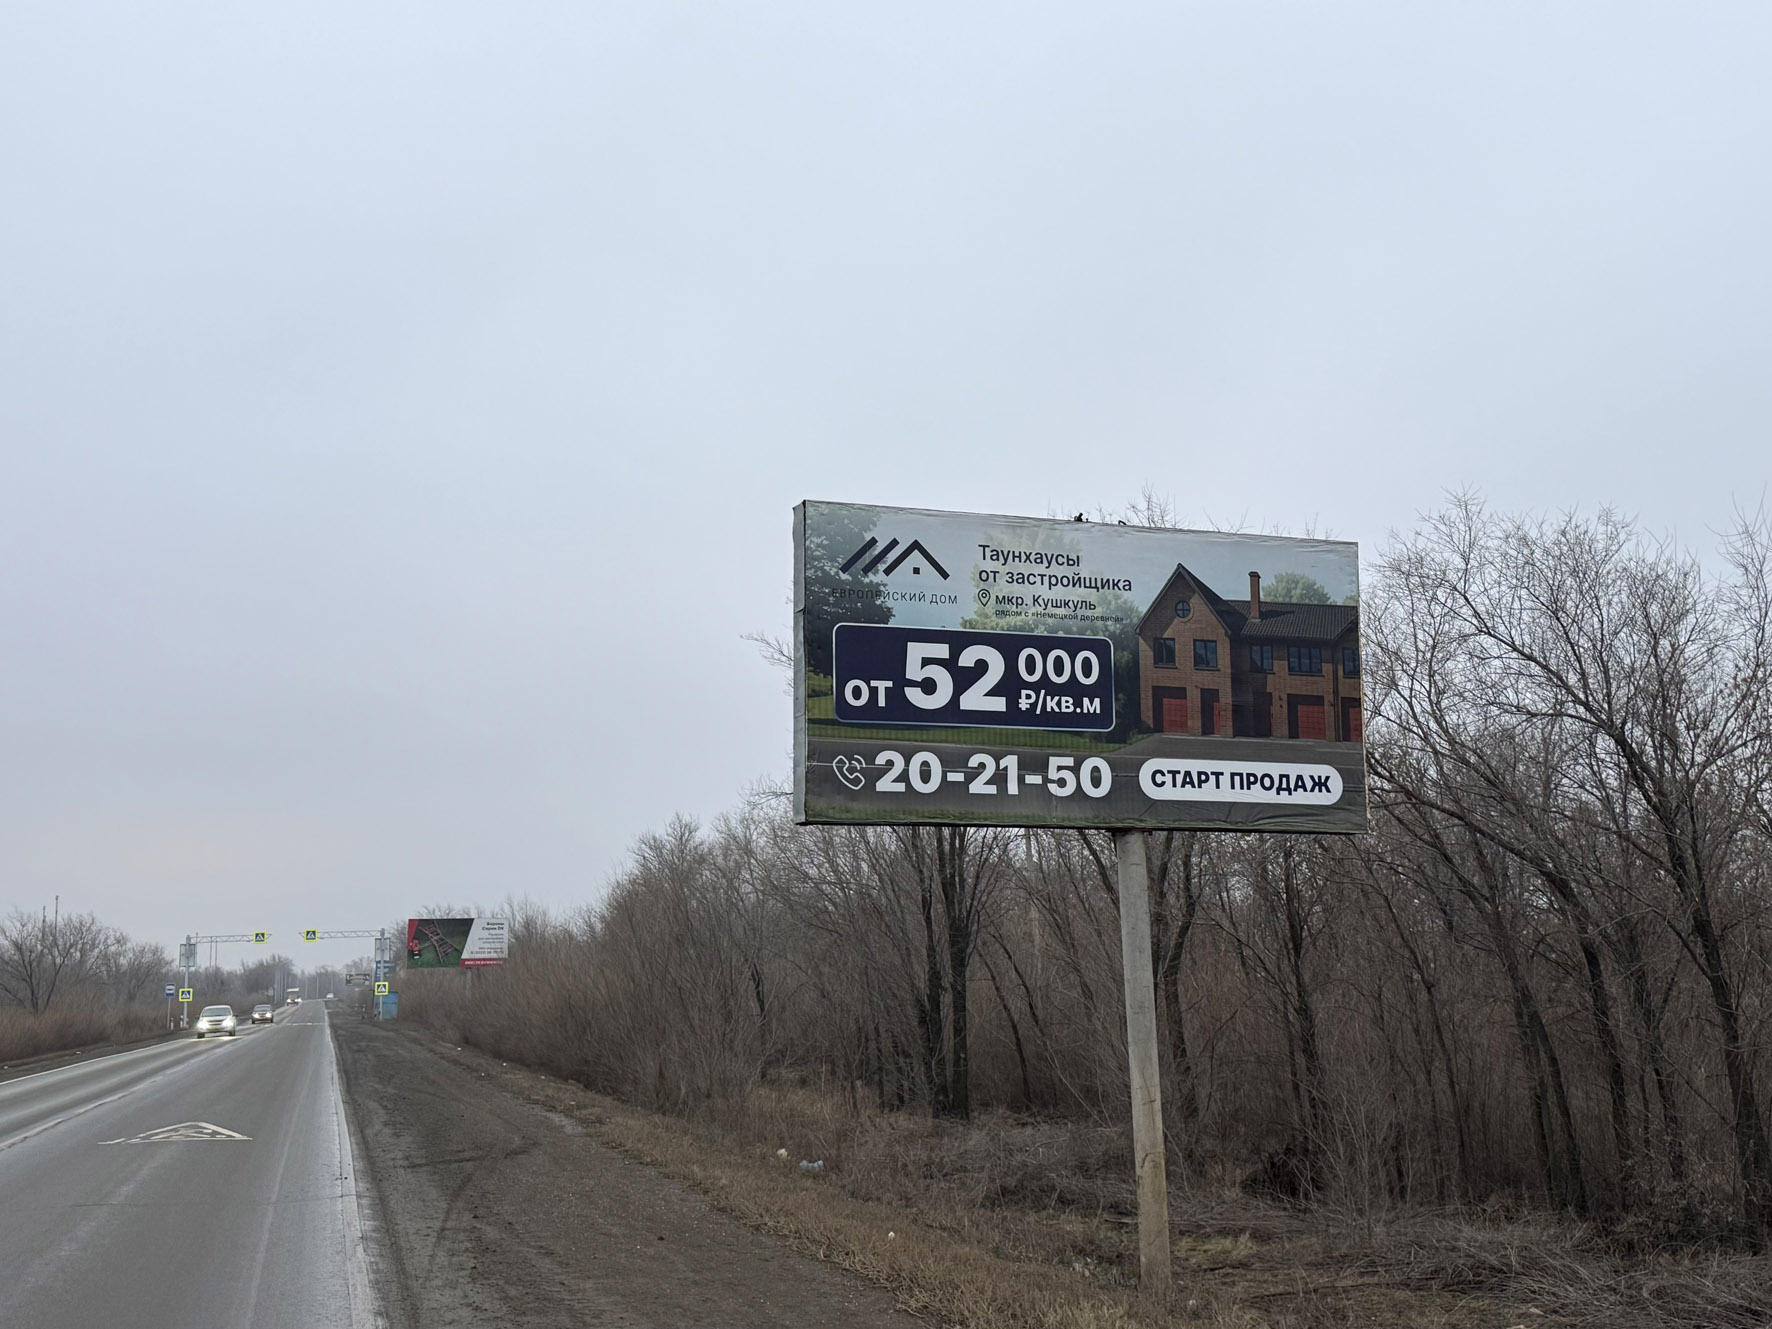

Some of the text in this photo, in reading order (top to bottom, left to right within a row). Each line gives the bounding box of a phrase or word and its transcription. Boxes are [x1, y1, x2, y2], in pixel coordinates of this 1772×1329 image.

[978, 544, 1080, 569] Таунхаусы
[978, 569, 1132, 592] от застройщика
[831, 588, 958, 605] ЕВРОПЕЙСКИЙ ДОМ
[995, 594, 1097, 612] мкр. Кушкуль
[995, 609, 1022, 618] рядом
[1031, 610, 1079, 621] «Немецкой
[844, 641, 1100, 712] от 52 000
[874, 750, 1112, 798] 20-21-50
[1151, 769, 1332, 796] СТАРТ ПРОДАЖ
